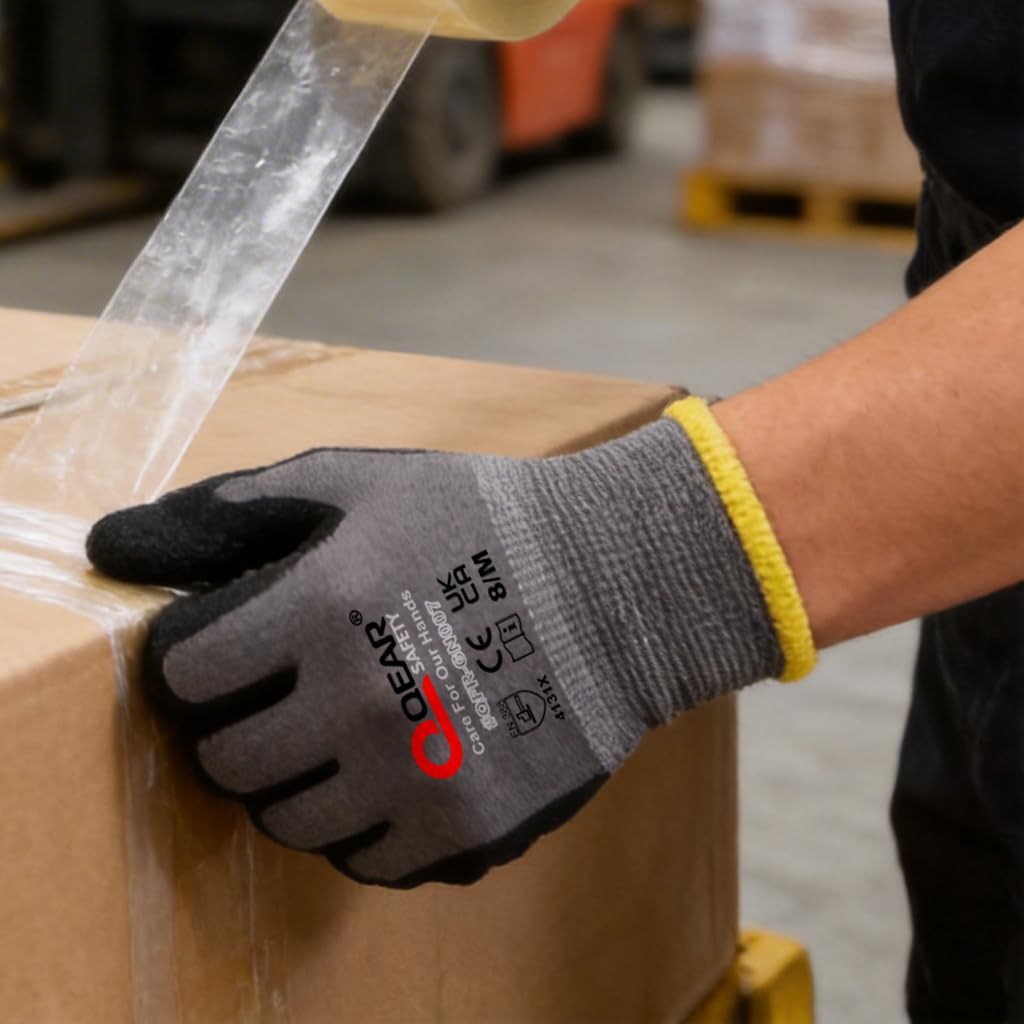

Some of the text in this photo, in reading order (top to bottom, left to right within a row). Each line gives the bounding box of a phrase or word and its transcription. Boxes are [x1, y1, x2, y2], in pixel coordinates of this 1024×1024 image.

[436, 572, 465, 613] UK
[452, 564, 480, 605] CA
[472, 549, 507, 602] 8/M
[386, 613, 425, 675] SAFETY
[466, 627, 503, 673] CE
[401, 589, 485, 755] Care For Our Hands
[537, 674, 565, 721] 4131X
